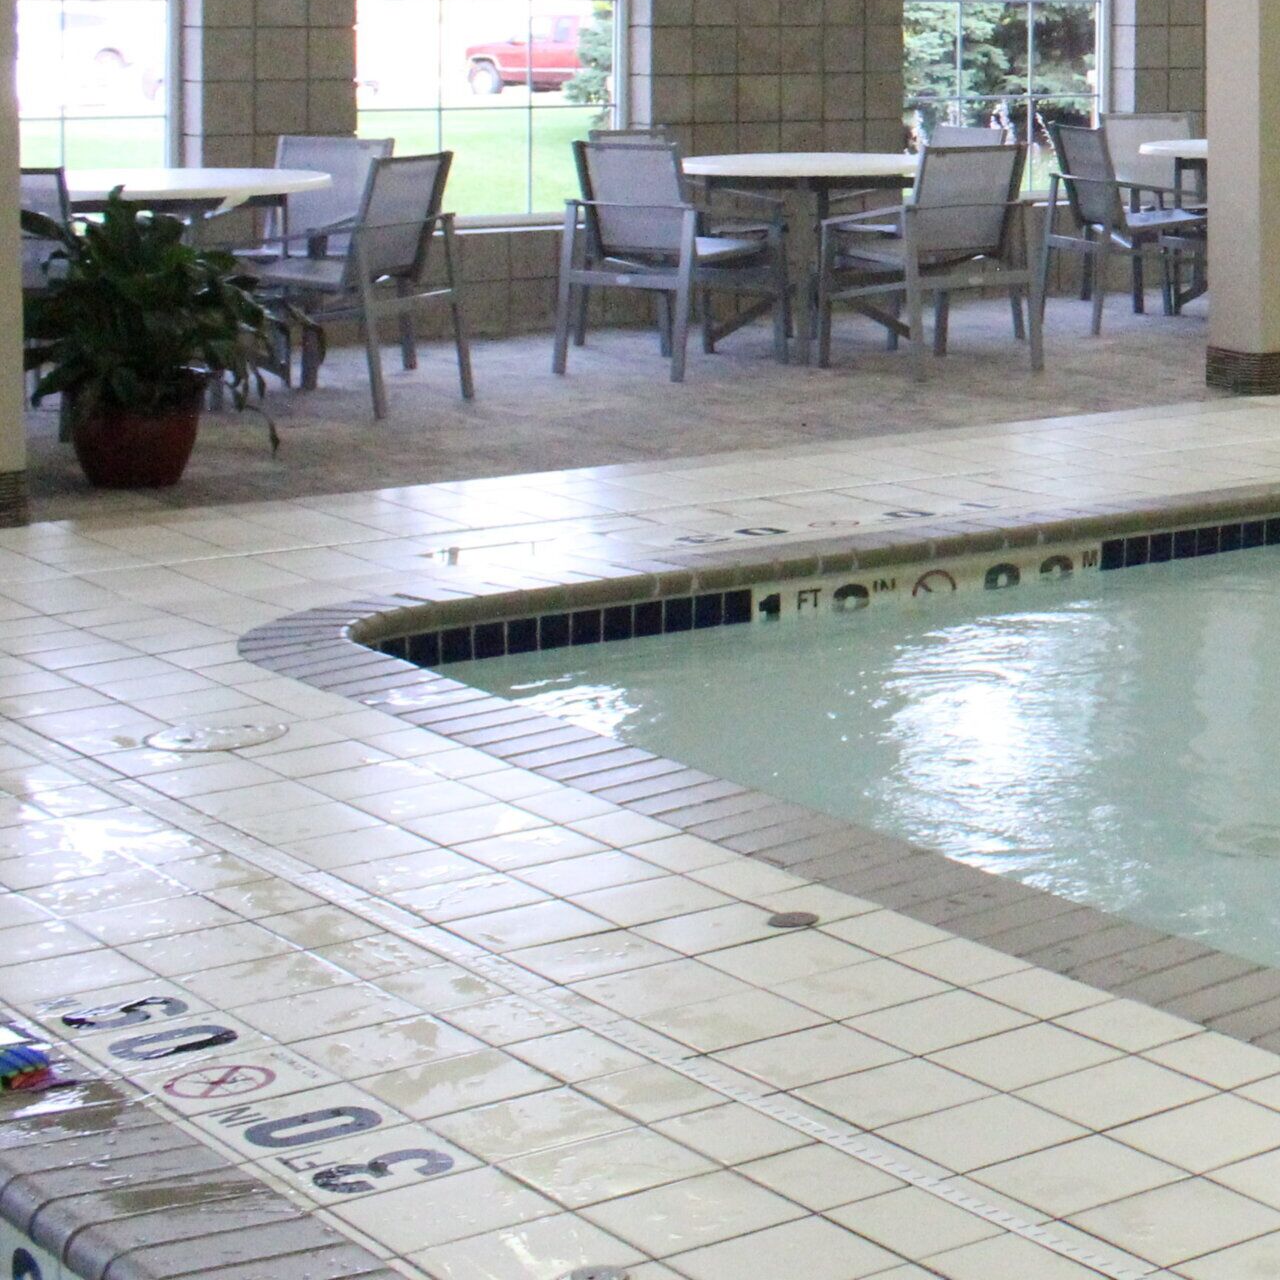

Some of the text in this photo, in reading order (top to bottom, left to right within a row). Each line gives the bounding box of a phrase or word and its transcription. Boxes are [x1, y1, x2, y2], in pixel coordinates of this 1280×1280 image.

[797, 588, 822, 610] FT
[208, 1105, 269, 1129] IN
[244, 1105, 383, 1149] 0
[274, 1150, 337, 1174] FT
[312, 1147, 455, 1195] 3
